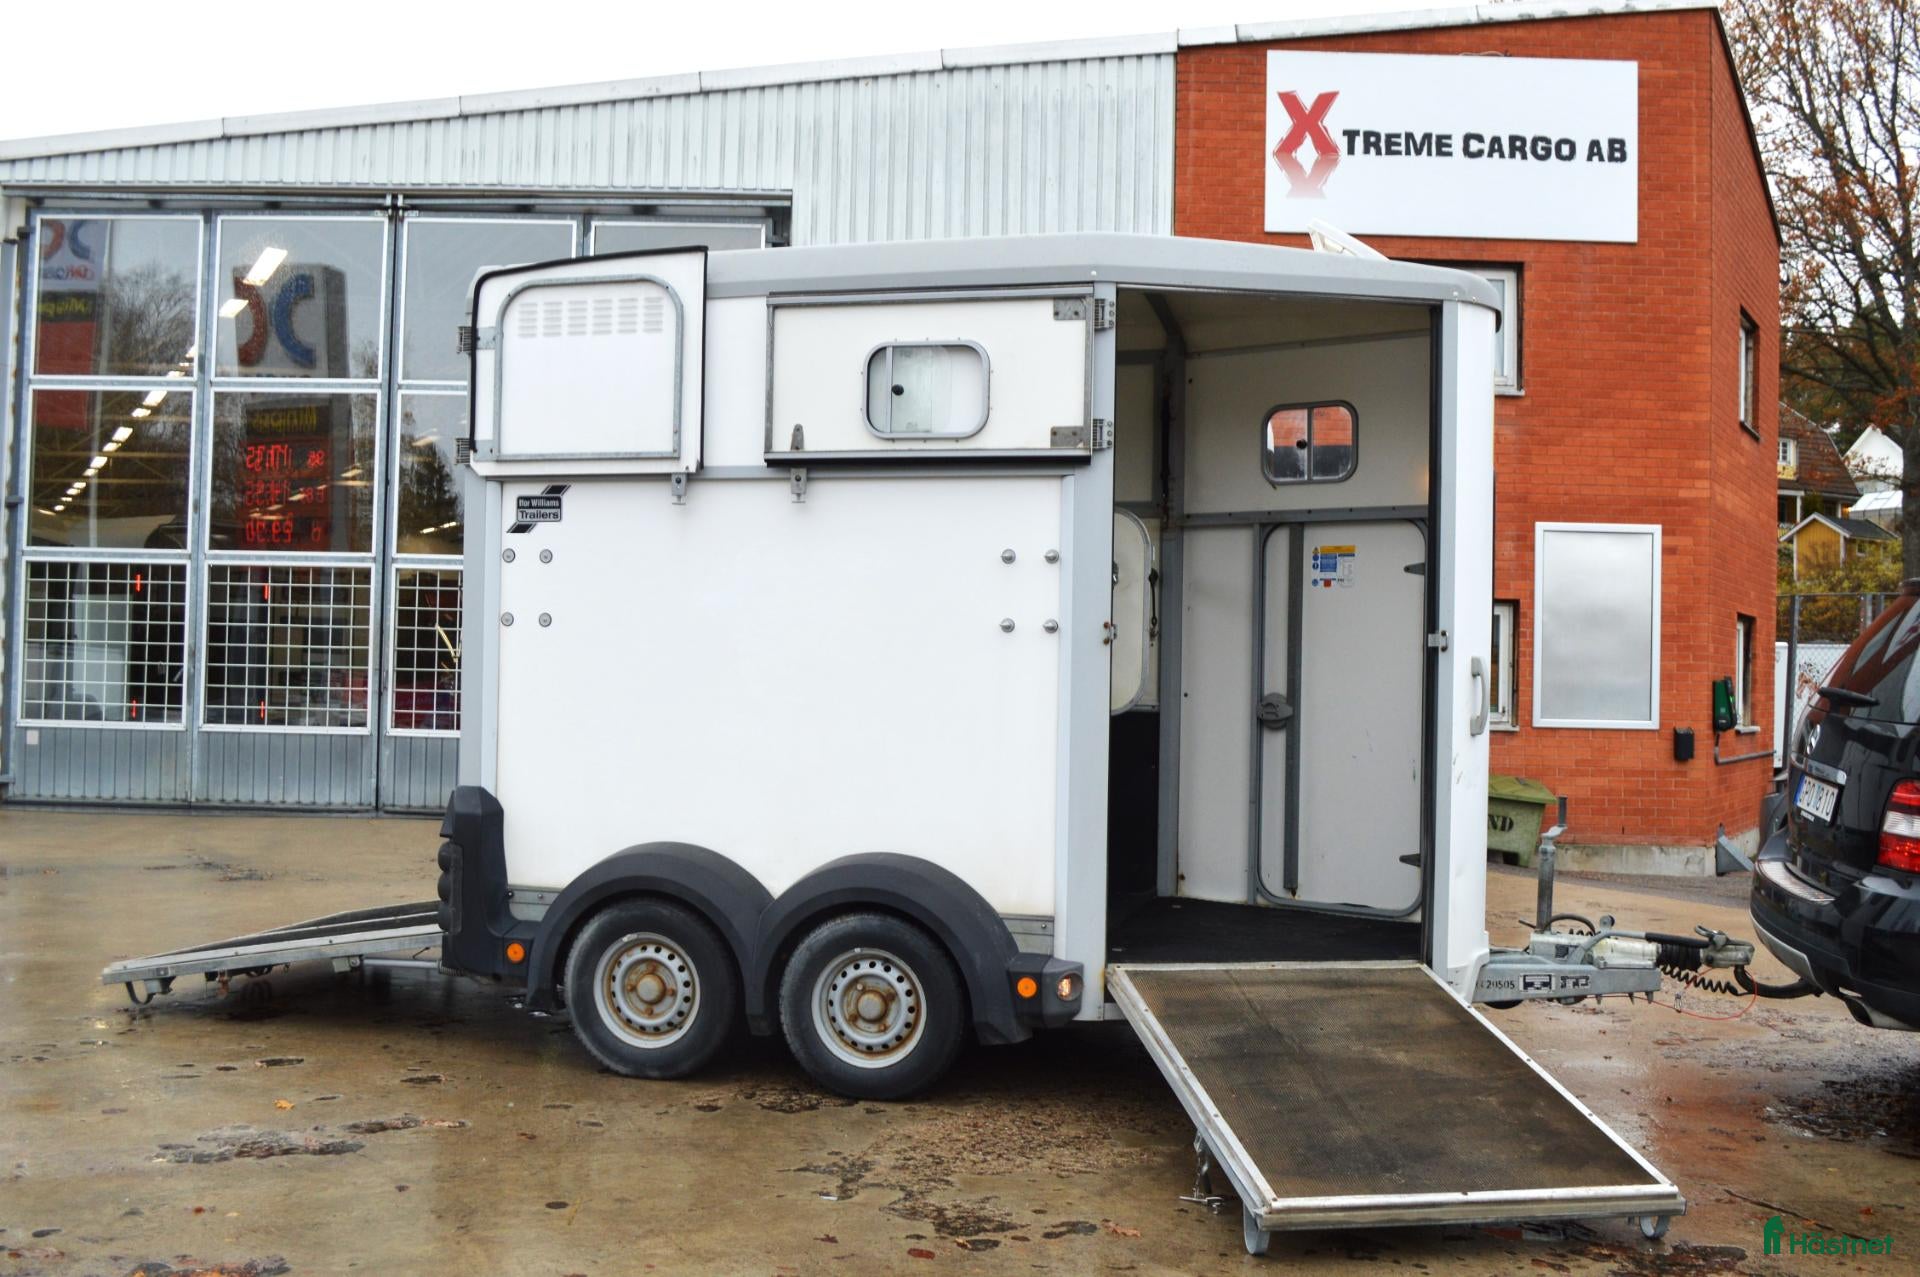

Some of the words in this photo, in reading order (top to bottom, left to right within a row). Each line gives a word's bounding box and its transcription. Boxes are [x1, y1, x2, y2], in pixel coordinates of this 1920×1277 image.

[1462, 132, 1577, 162] CARGO
[1586, 138, 1628, 164] AB
[531, 499, 560, 507] Williams
[519, 510, 559, 519] Trailers
